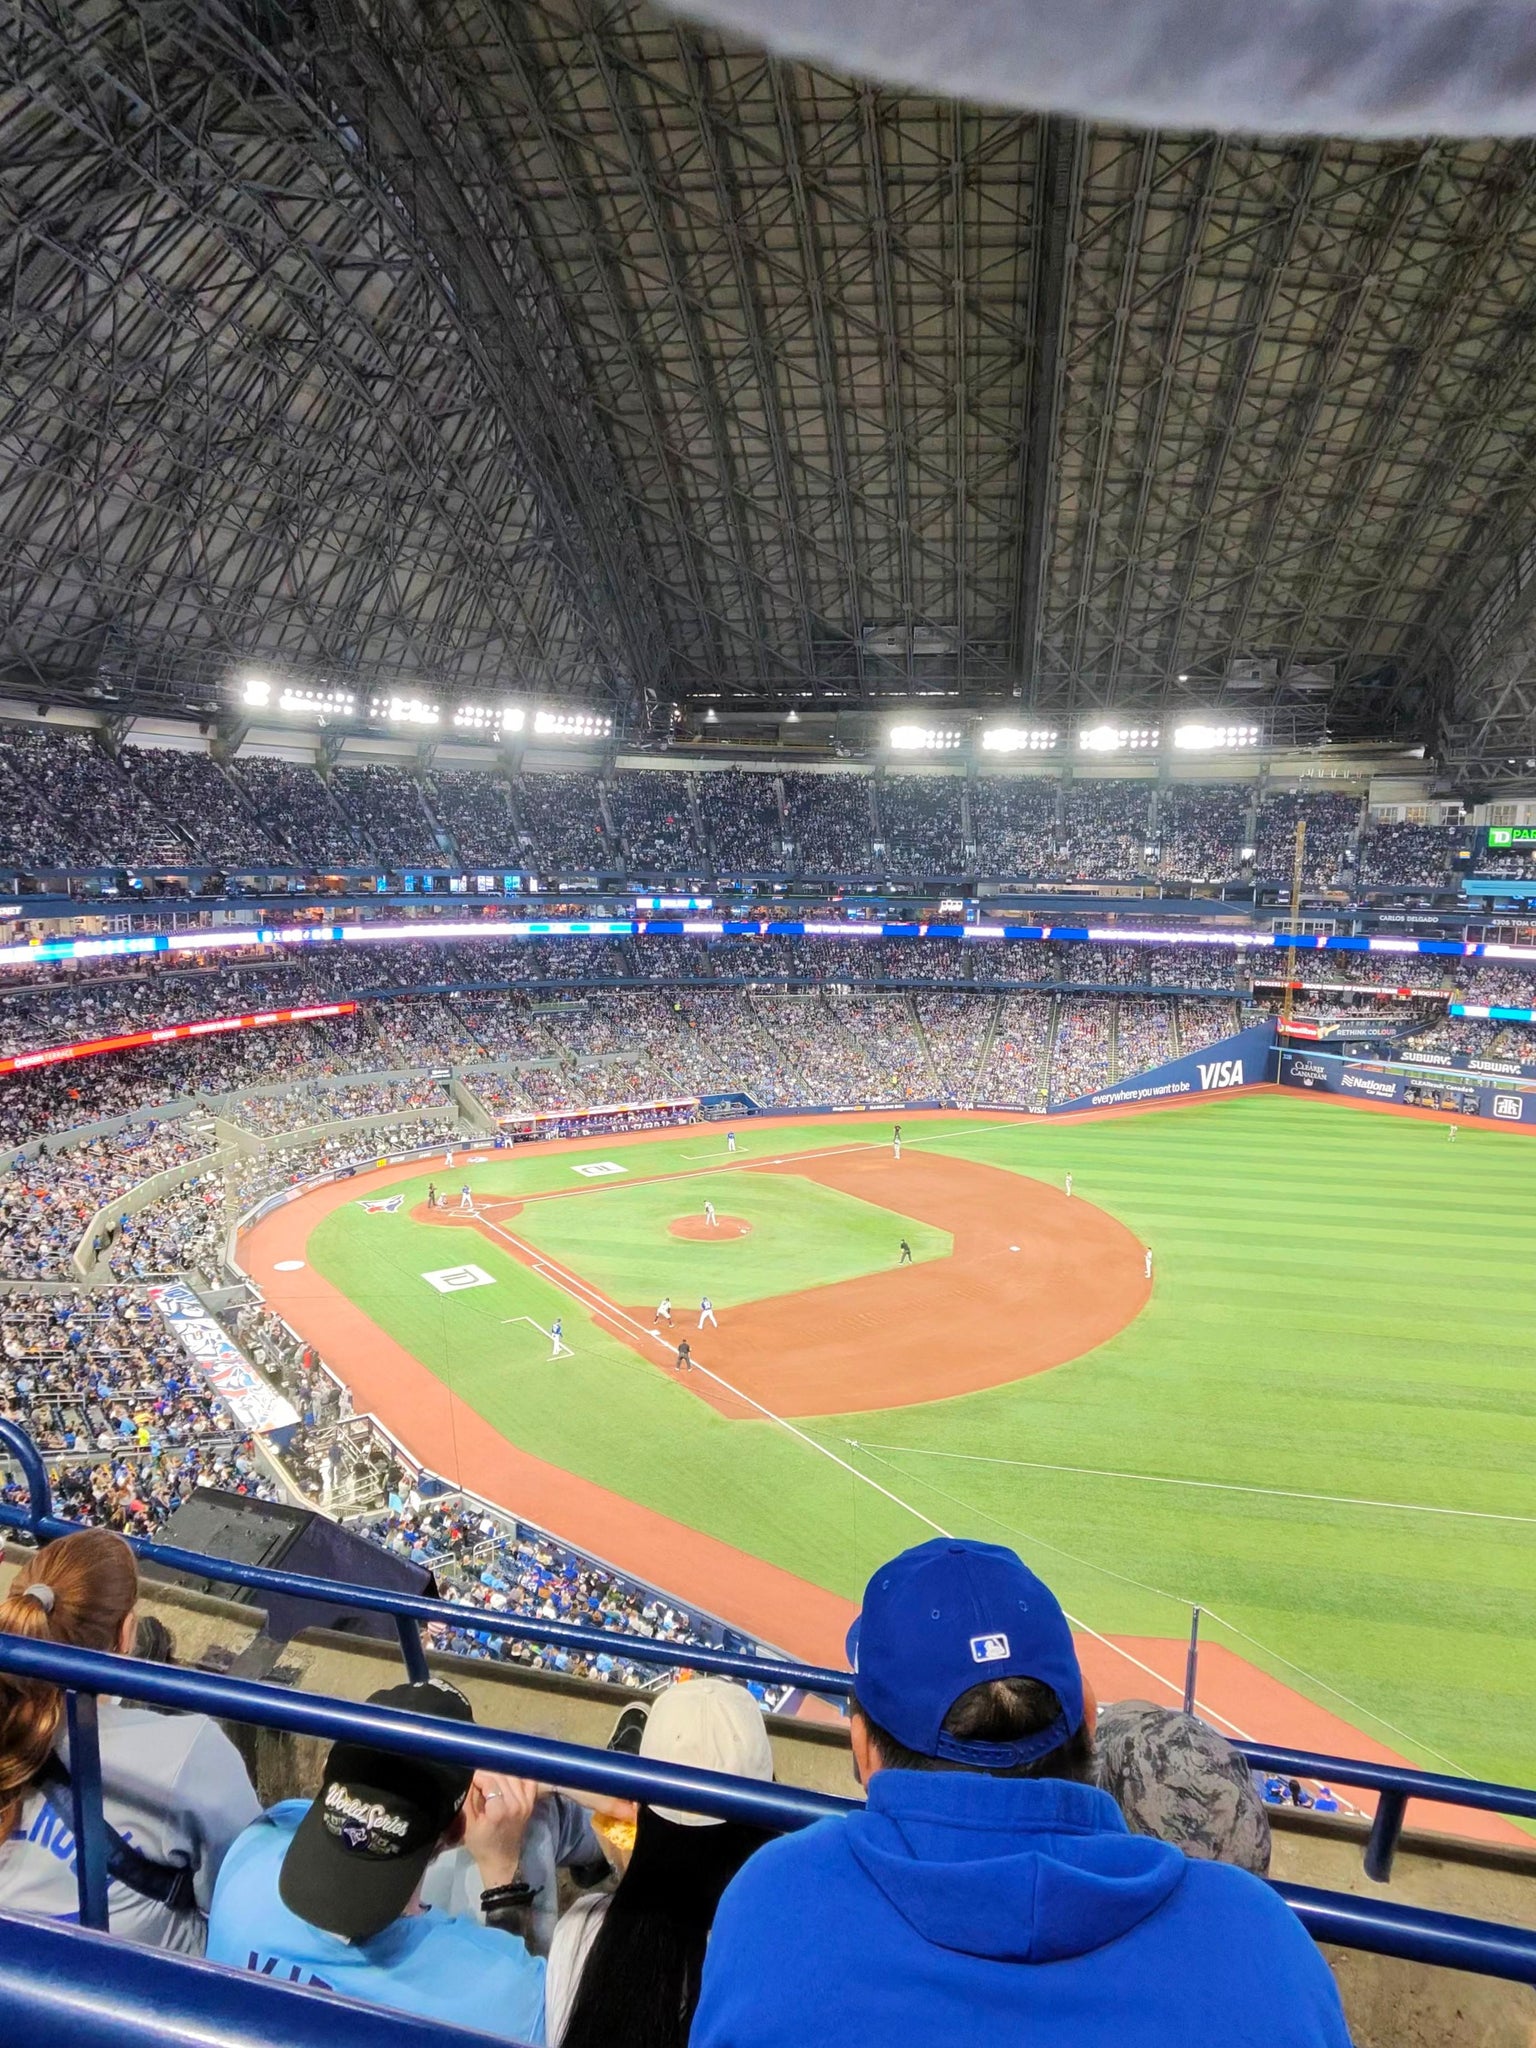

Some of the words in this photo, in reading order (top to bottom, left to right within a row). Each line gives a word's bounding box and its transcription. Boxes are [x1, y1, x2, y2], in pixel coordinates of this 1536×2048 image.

[1494, 831, 1511, 843] TD
[1379, 914, 1405, 922] CARLOS
[1407, 914, 1439, 923] DELGADO
[1400, 1052, 1451, 1066] SUBWAY
[1196, 1059, 1244, 1090] VISA
[1468, 1060, 1521, 1075] SUBWAY
[1353, 1077, 1396, 1093] National
[1092, 1090, 1138, 1105] everywhere
[1138, 1088, 1153, 1100] you
[1152, 1084, 1172, 1095] want
[1171, 1083, 1180, 1093] to
[1180, 1081, 1190, 1092] be
[1028, 1106, 1047, 1114] VISA
[325, 1782, 371, 1823] World
[366, 1804, 409, 1837] Series
